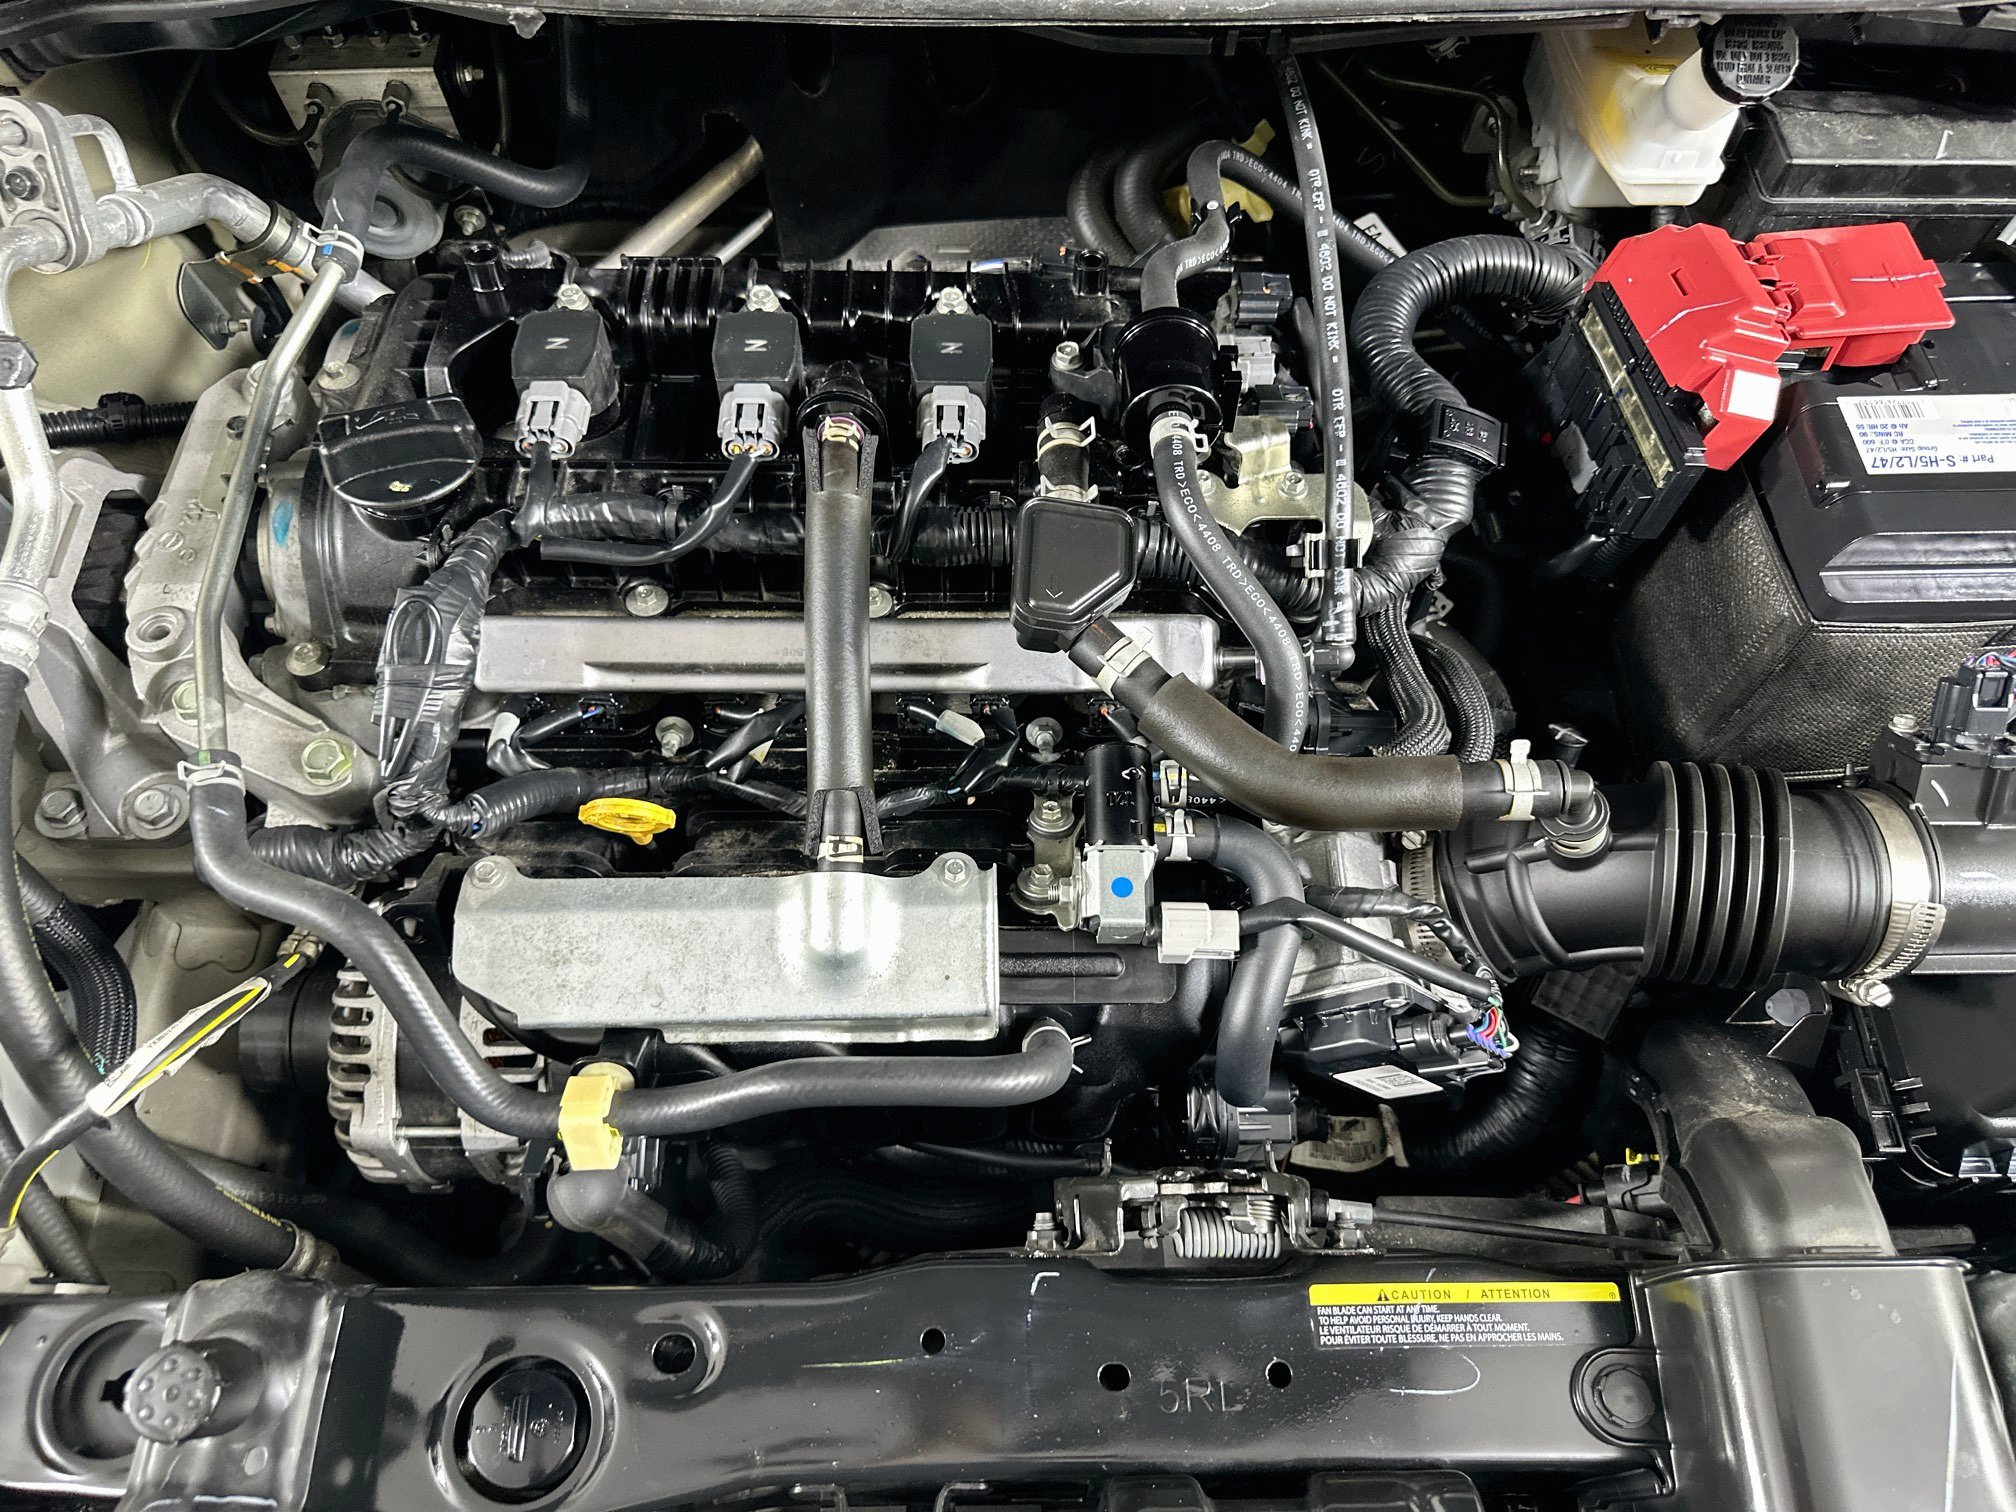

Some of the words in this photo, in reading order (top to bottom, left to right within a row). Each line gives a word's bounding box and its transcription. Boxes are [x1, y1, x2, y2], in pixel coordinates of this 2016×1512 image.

[1298, 118, 1313, 141] KINK
[1323, 295, 1337, 317] NOT
[1326, 322, 1340, 351] KINK
[1871, 454, 1957, 469] S-H5/L2/47
[1971, 454, 1994, 464] Part
[1391, 1289, 1452, 1300] CAUTION
[1480, 1288, 1551, 1300] ATTENTION
[1317, 1306, 1332, 1316] FAN
[1332, 1306, 1356, 1315] BLADE
[1356, 1305, 1373, 1315] CAN
[1373, 1305, 1395, 1314] START
[1395, 1304, 1406, 1314] AT
[1405, 1304, 1421, 1314] ANY
[1421, 1304, 1441, 1314] TIME.
[1318, 1316, 1330, 1325] TO
[1330, 1316, 1349, 1325] HELP
[1349, 1315, 1373, 1325] AVOID
[1373, 1315, 1410, 1324] PERSONAL
[1410, 1314, 1436, 1324] INJURY,
[1436, 1314, 1454, 1323] KEEP
[1454, 1313, 1479, 1323] HANDS
[1480, 1313, 1503, 1322] CLEAR.
[1319, 1326, 1330, 1335] LE
[1330, 1325, 1382, 1335] VENTILATEUR
[1382, 1324, 1412, 1334] RISQUE
[1413, 1324, 1424, 1333] DE
[1424, 1320, 1466, 1333] DÉMARRER
[1472, 1323, 1494, 1332] TOUT
[1494, 1323, 1530, 1332] MOMENT.
[1320, 1335, 1343, 1345] POUR
[1344, 1332, 1371, 1344] ÉVITER
[1371, 1334, 1398, 1344] TOUTE
[1398, 1333, 1439, 1344] BLESSURE,
[1438, 1333, 1450, 1342] NE
[1450, 1333, 1465, 1342] PAS
[1466, 1333, 1477, 1342] EN
[1477, 1333, 1524, 1342] APPROCHER
[1523, 1332, 1537, 1341] LES
[1537, 1332, 1564, 1341] MAINS.
[1160, 1378, 1245, 1413] 5RL
